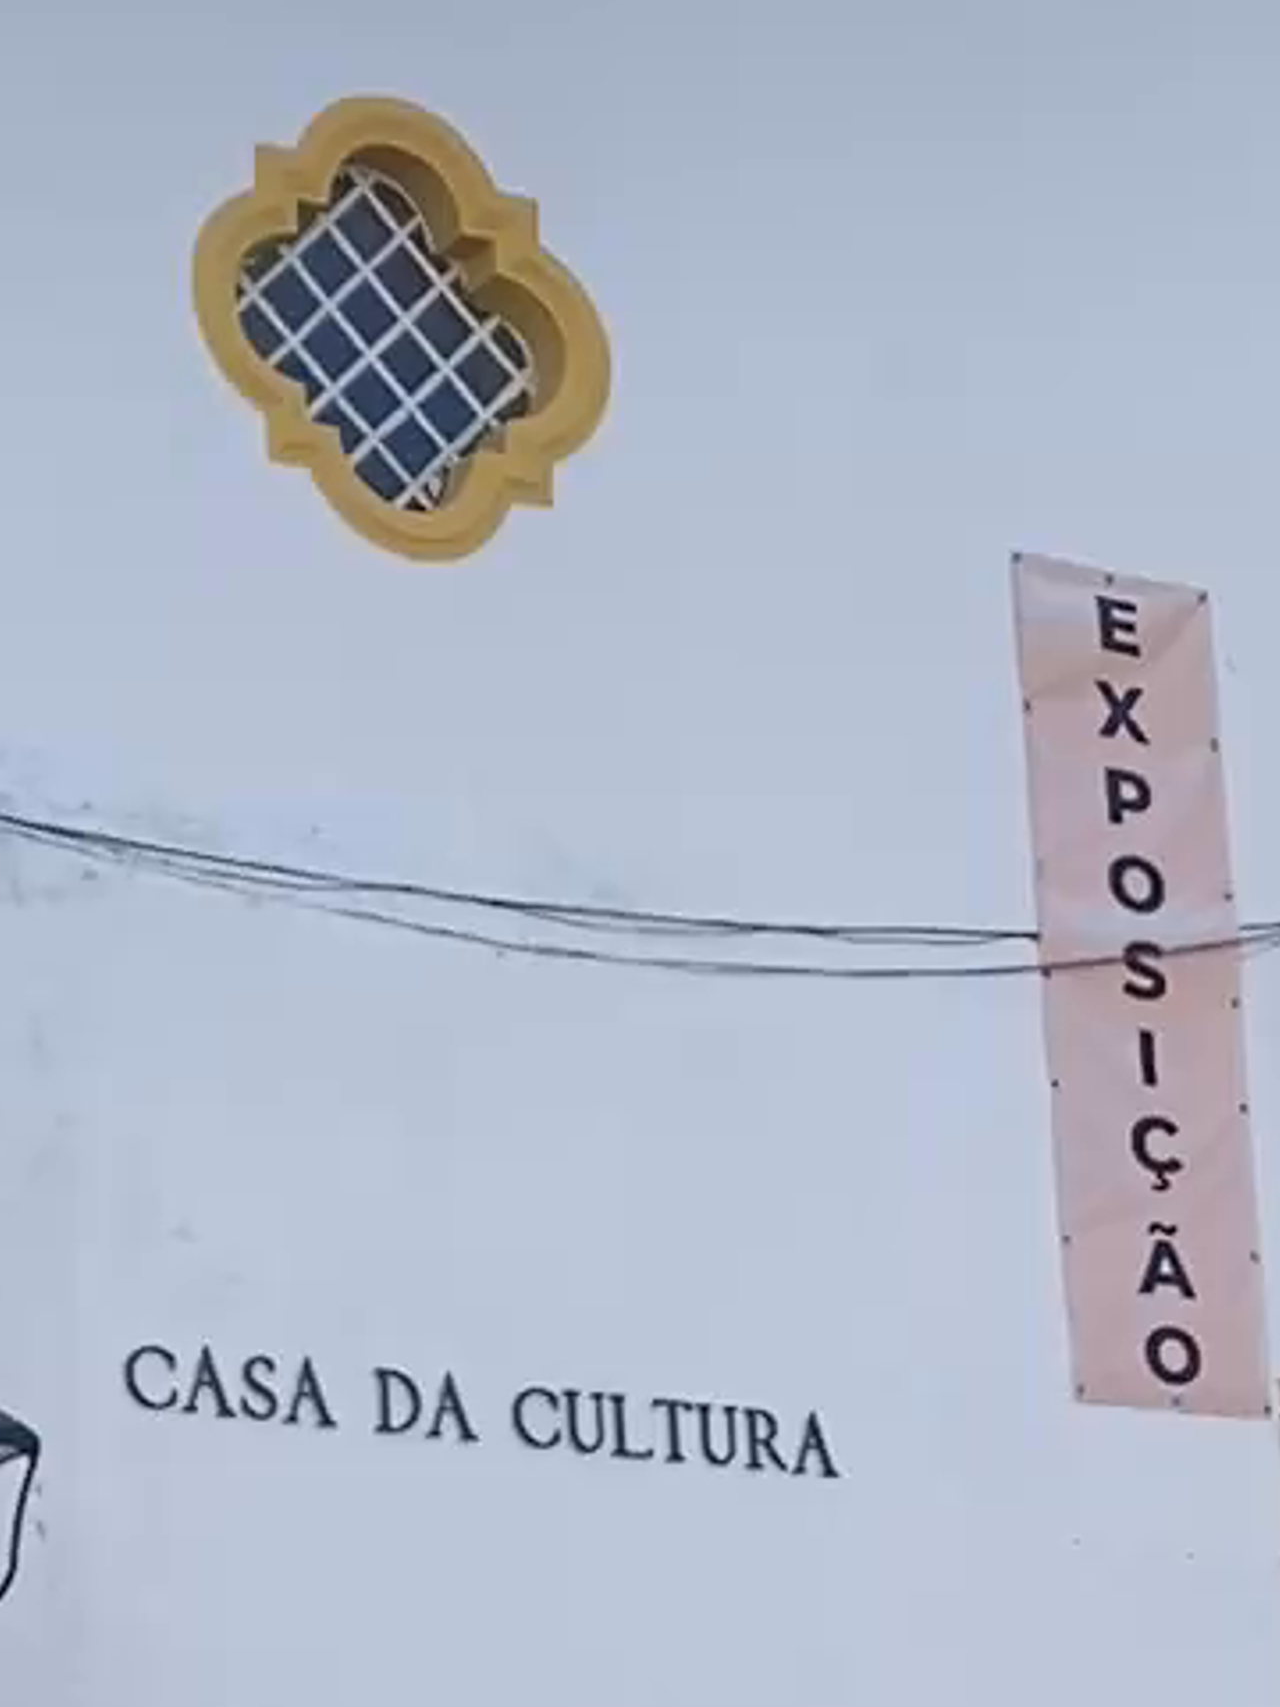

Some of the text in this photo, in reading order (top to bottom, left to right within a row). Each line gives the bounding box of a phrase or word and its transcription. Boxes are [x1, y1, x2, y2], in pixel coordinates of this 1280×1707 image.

[1095, 594, 1203, 1389] EXPOSIÇÃO
[122, 1343, 841, 1480] CASA DA CULTURA
